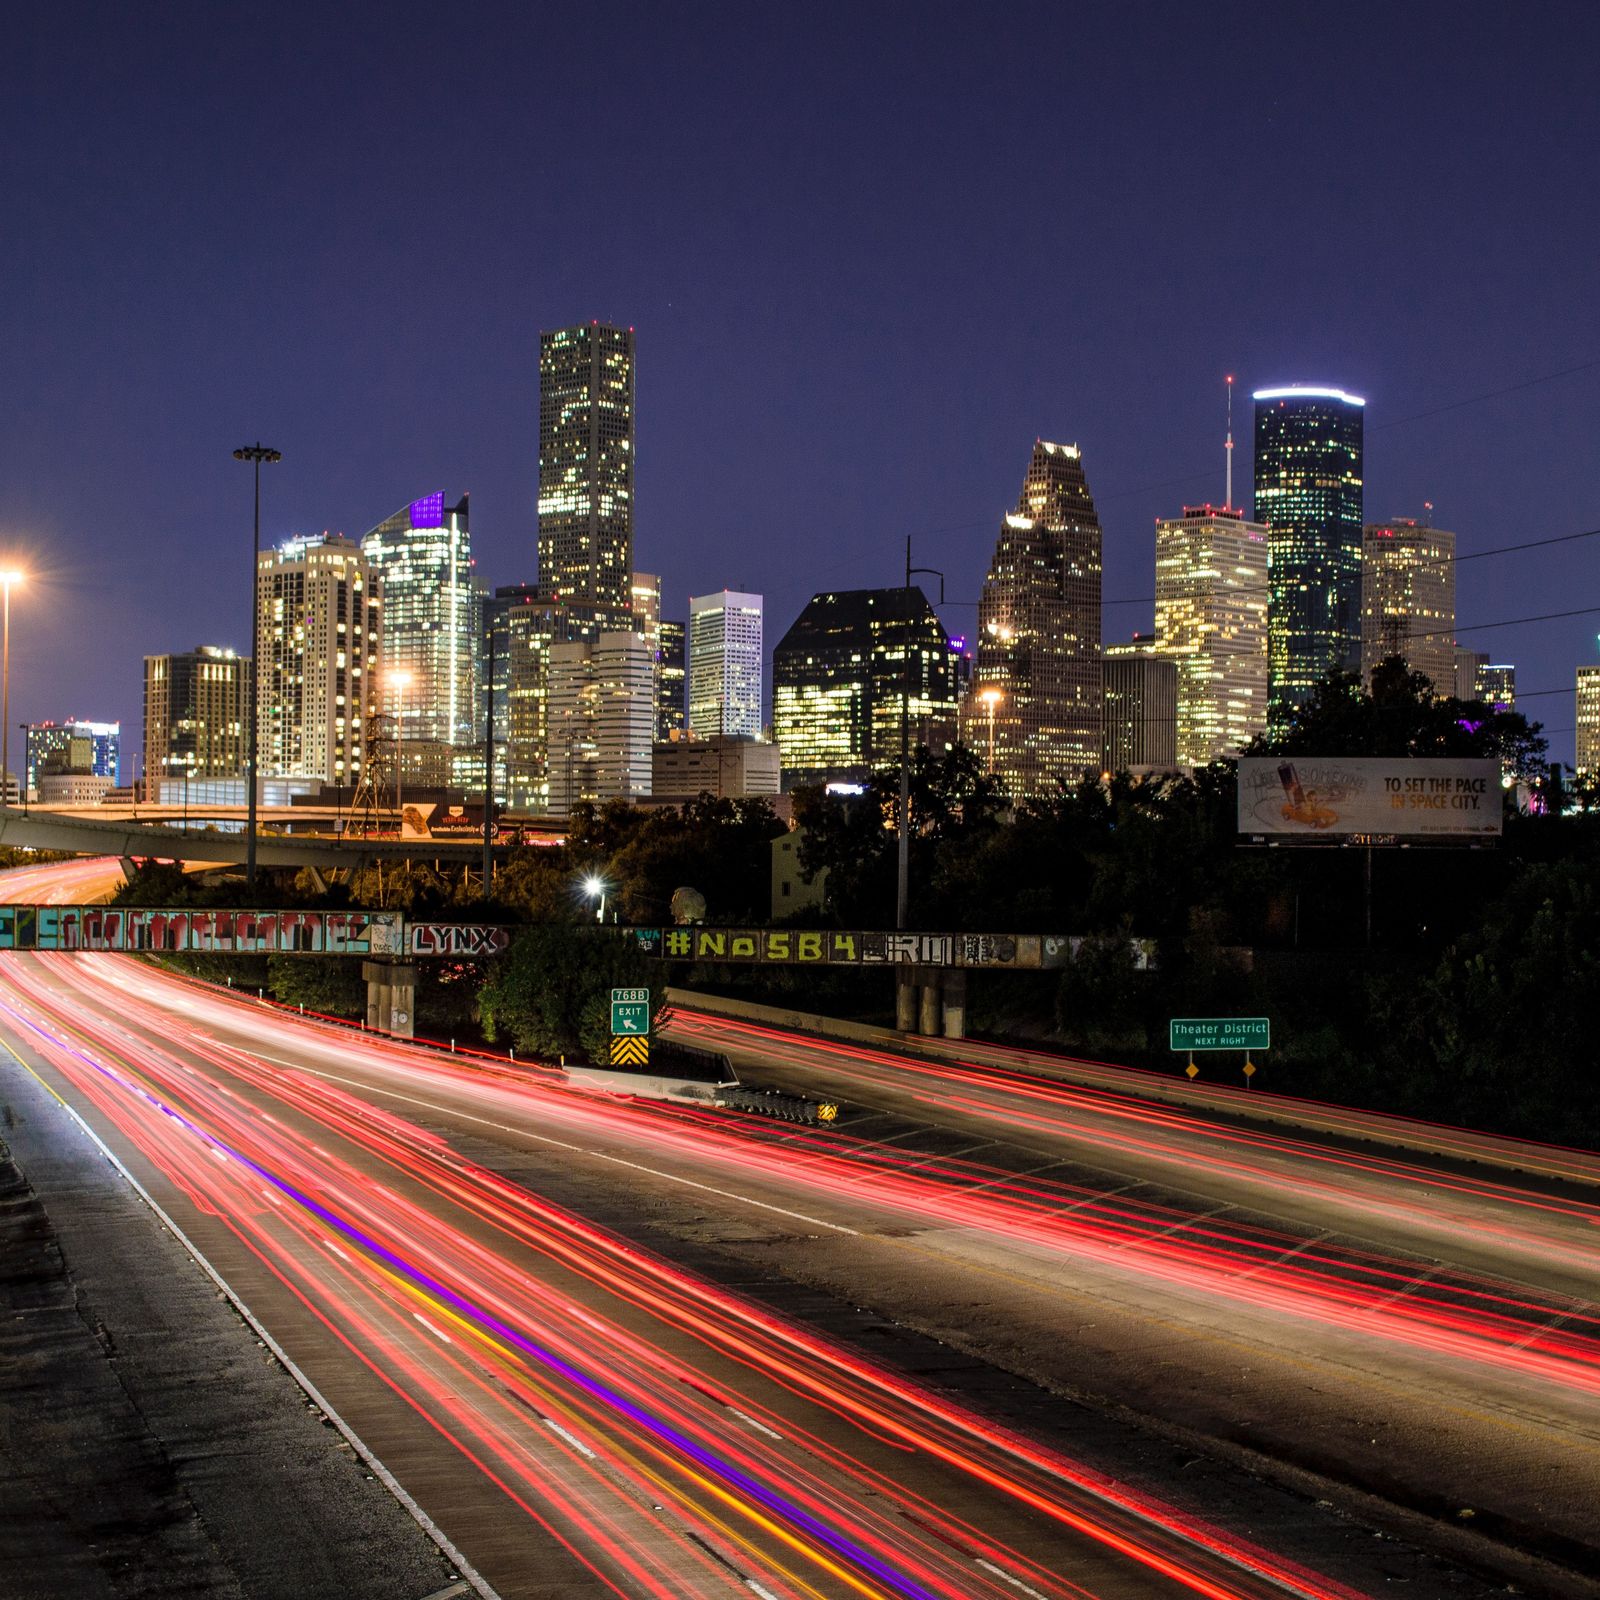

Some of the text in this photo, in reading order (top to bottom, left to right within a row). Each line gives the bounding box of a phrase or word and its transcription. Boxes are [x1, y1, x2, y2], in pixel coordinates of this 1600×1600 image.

[1384, 778, 1486, 793] TO SET THE PACE
[1391, 794, 1480, 810] IN SPACE CITY.
[412, 925, 498, 954] LYNX
[616, 991, 645, 1000] 768B
[1174, 1023, 1266, 1034] Theater District
